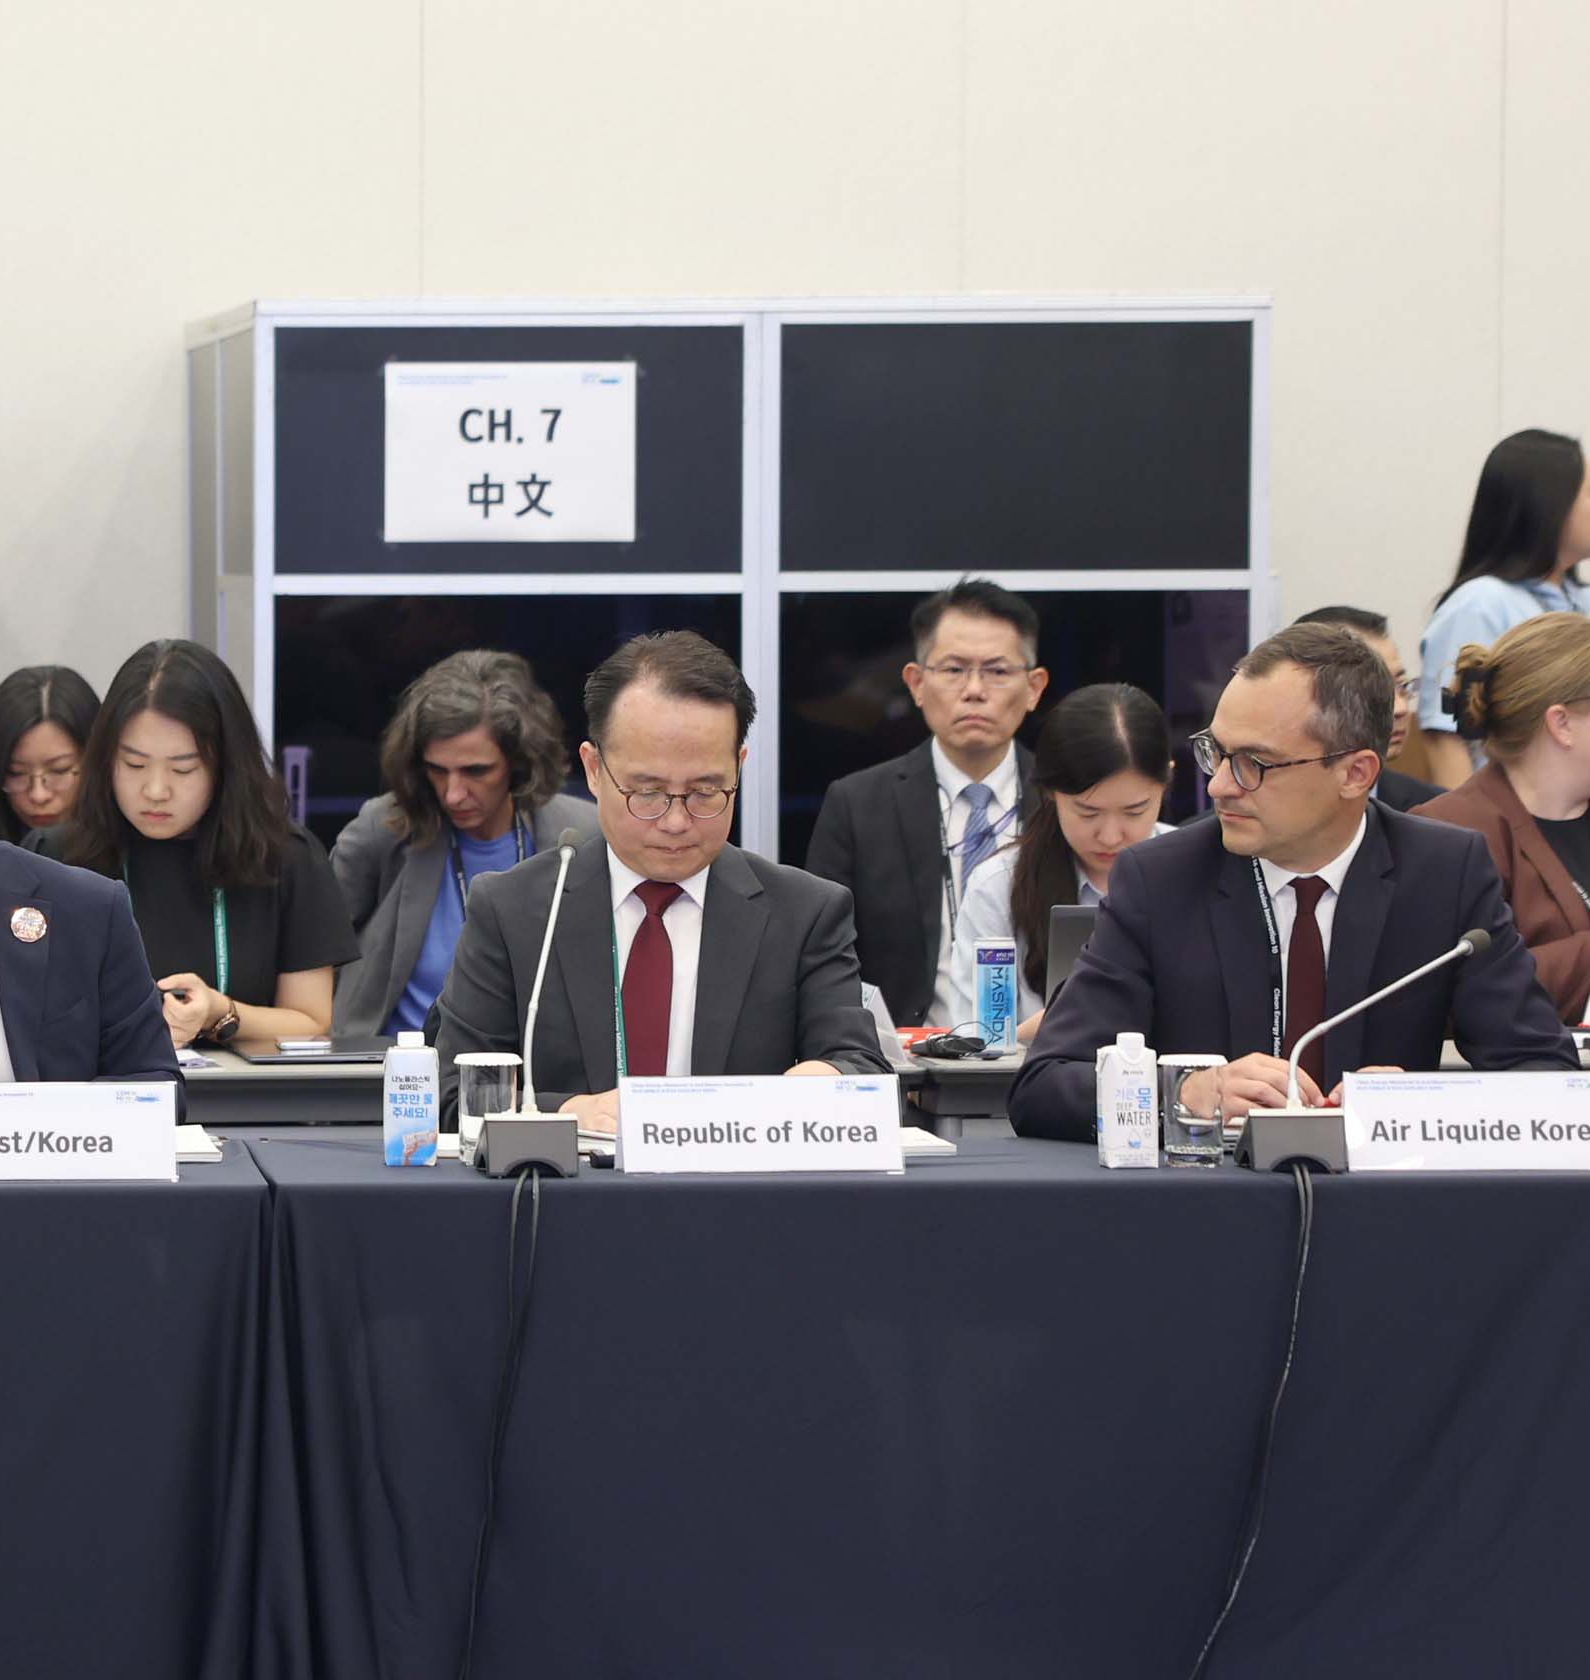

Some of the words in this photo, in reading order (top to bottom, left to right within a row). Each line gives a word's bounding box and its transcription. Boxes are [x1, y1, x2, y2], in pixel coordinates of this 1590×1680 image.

[459, 408, 524, 444] CH.
[540, 408, 562, 443] 7
[468, 472, 553, 519] 中文
[1257, 881, 1269, 908] Mission
[1263, 908, 1277, 945] Innovation
[1272, 1010, 1281, 1035] Energy
[1116, 1111, 1152, 1126] WATER
[1370, 1119, 1411, 1142] Air
[1420, 1118, 1521, 1145] Liquide
[642, 1121, 757, 1147] Republic
[766, 1120, 793, 1144] of
[802, 1121, 878, 1143] Korea
